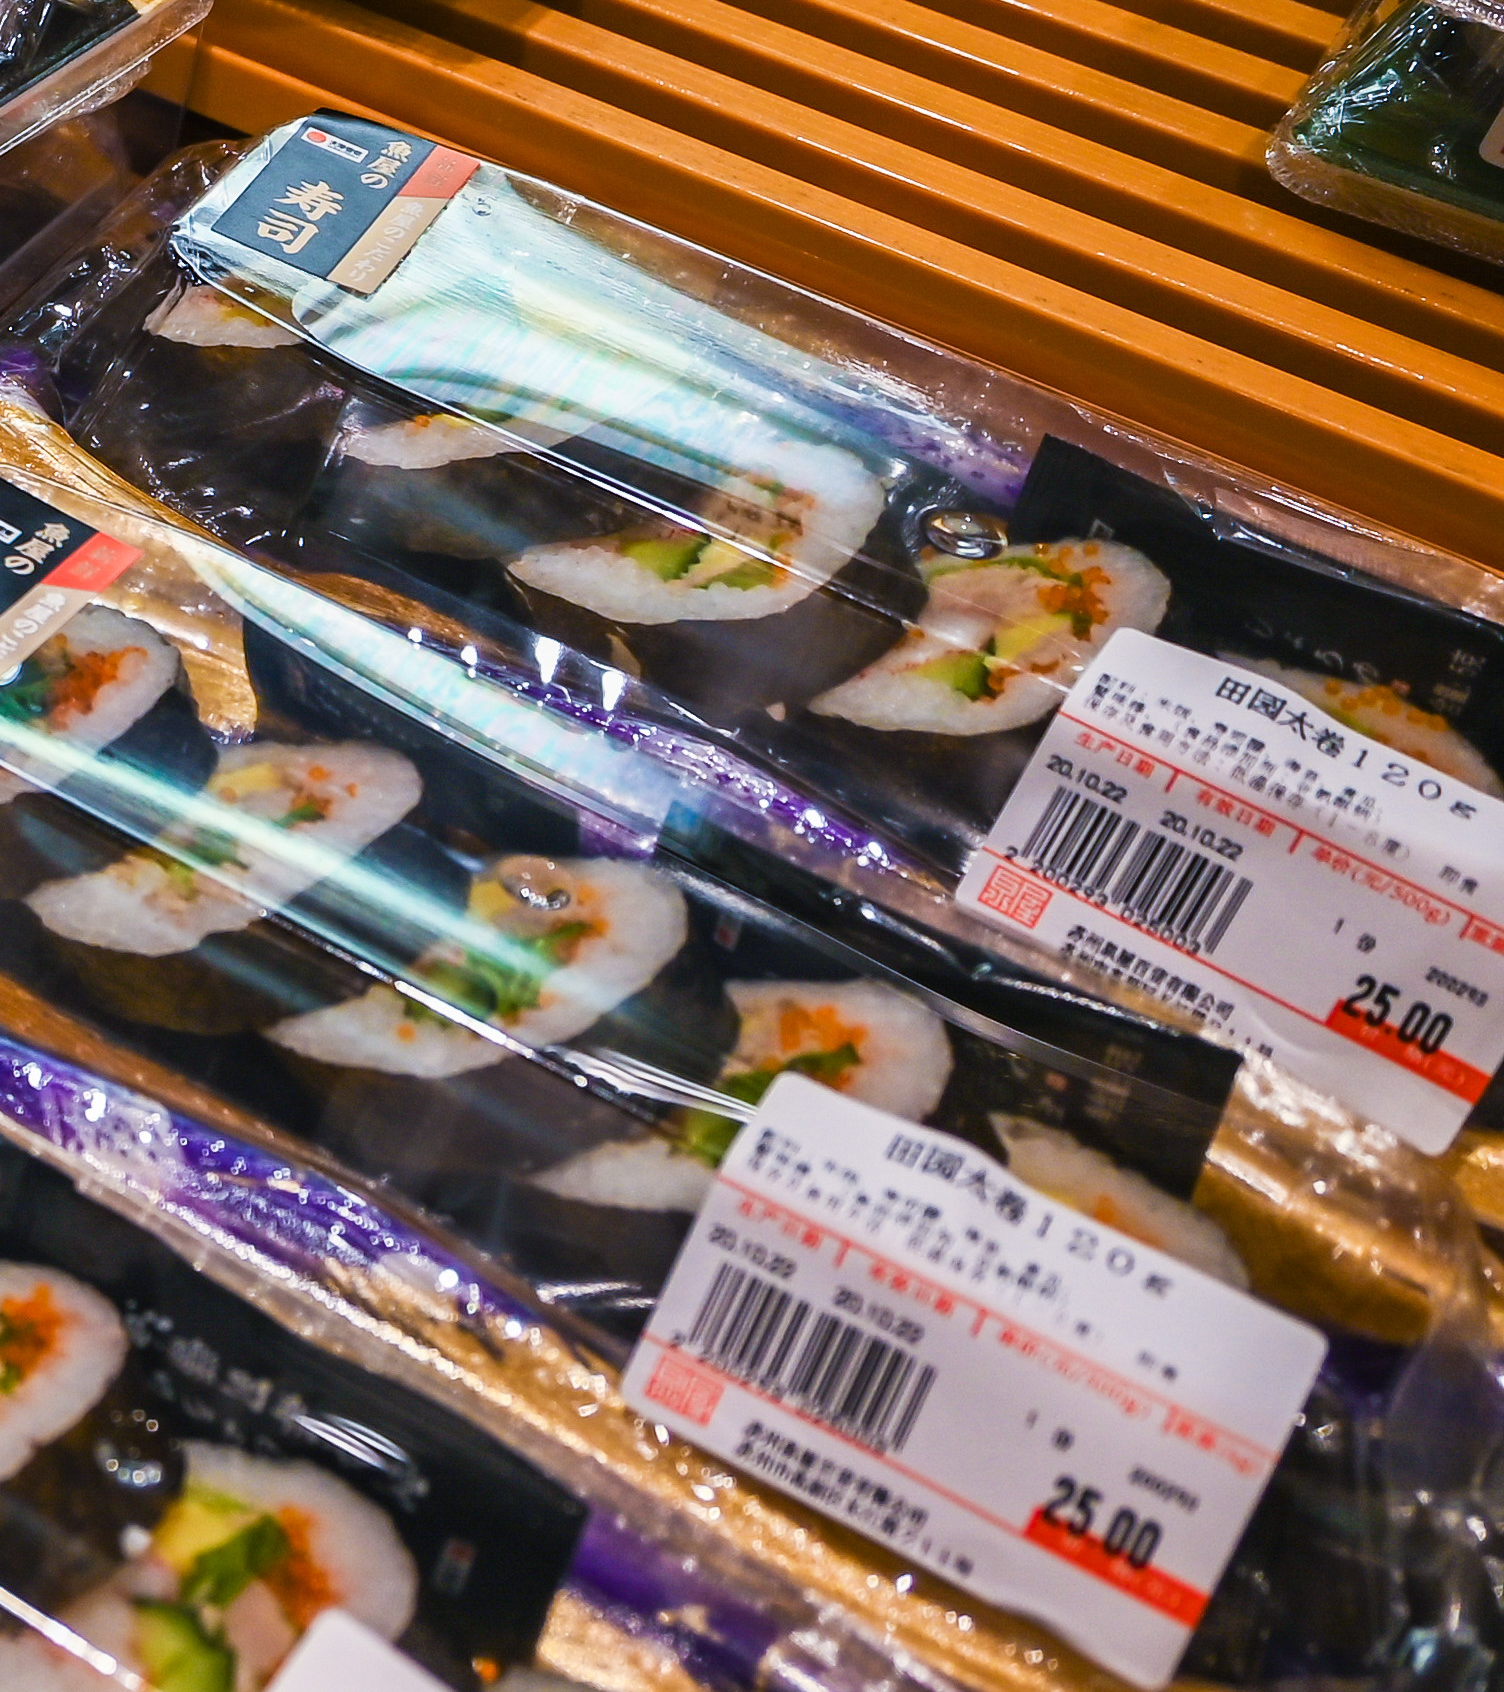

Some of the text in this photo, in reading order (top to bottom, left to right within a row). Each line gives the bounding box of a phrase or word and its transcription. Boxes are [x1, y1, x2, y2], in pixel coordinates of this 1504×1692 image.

[360, 140, 413, 190] 魚屋の
[257, 179, 345, 254] 寿司
[348, 201, 426, 282] 魚屋のこだわり
[3, 522, 71, 575] 魚屋の
[1045, 754, 1244, 862] 20.10.22 20.10.22
[1342, 975, 1455, 1055] 25.00
[1042, 1475, 1163, 1570] 25.00
